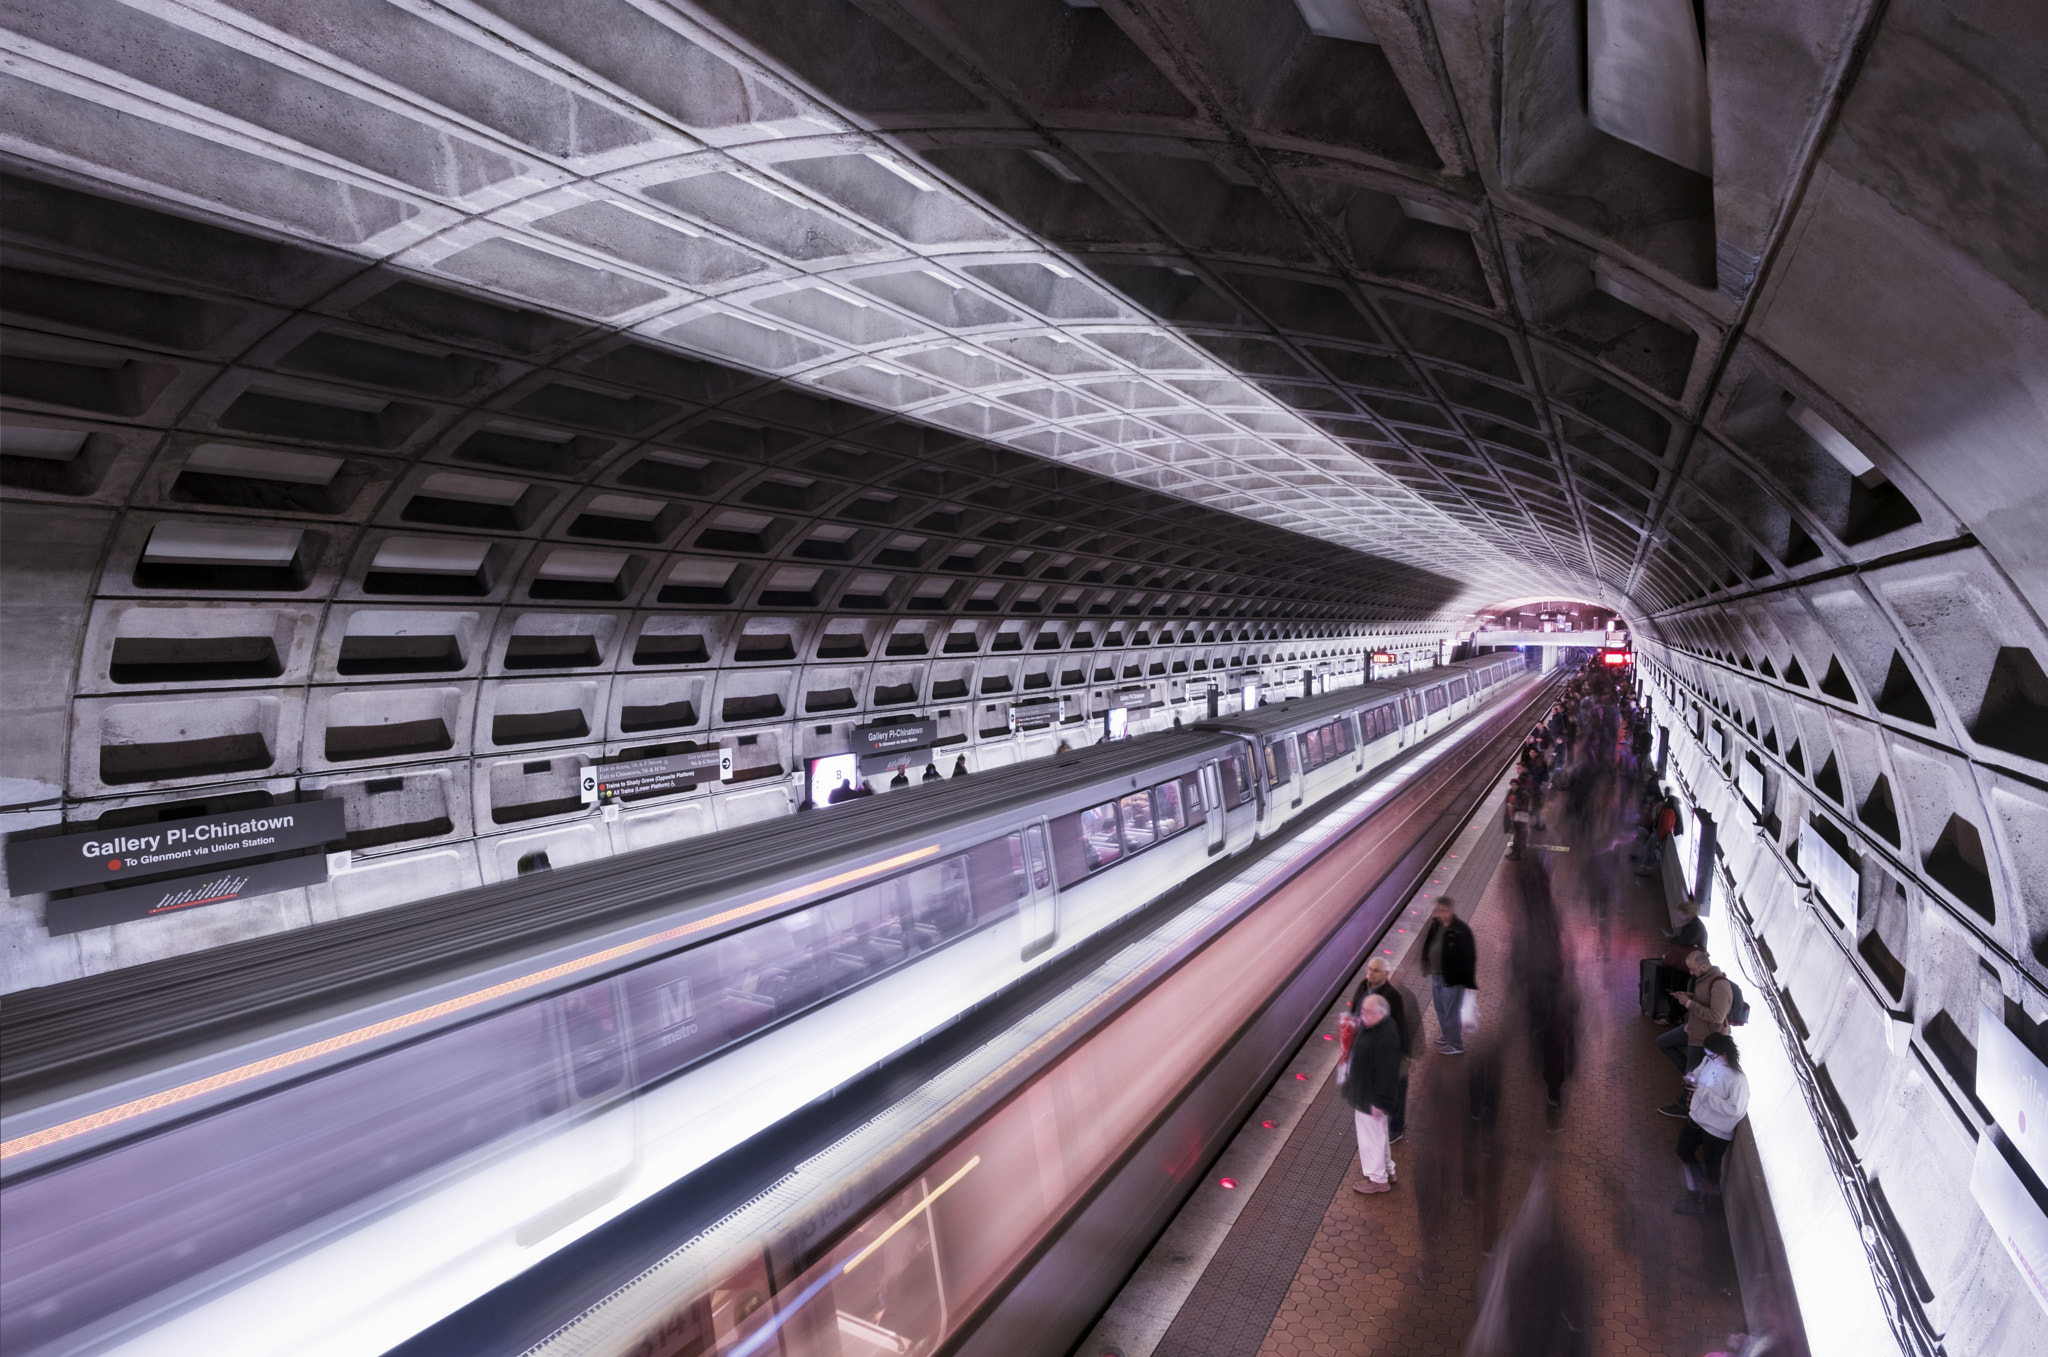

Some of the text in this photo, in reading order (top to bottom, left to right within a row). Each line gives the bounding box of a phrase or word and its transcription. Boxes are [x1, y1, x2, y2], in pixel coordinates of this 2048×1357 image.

[868, 732, 888, 741] Gallery
[627, 778, 640, 787] Shady
[82, 815, 294, 858] Gallery Pl-Chinatown
[125, 835, 275, 867] To Glenmont via Union Station
[660, 980, 693, 1028] M
[662, 1023, 698, 1048] metro
